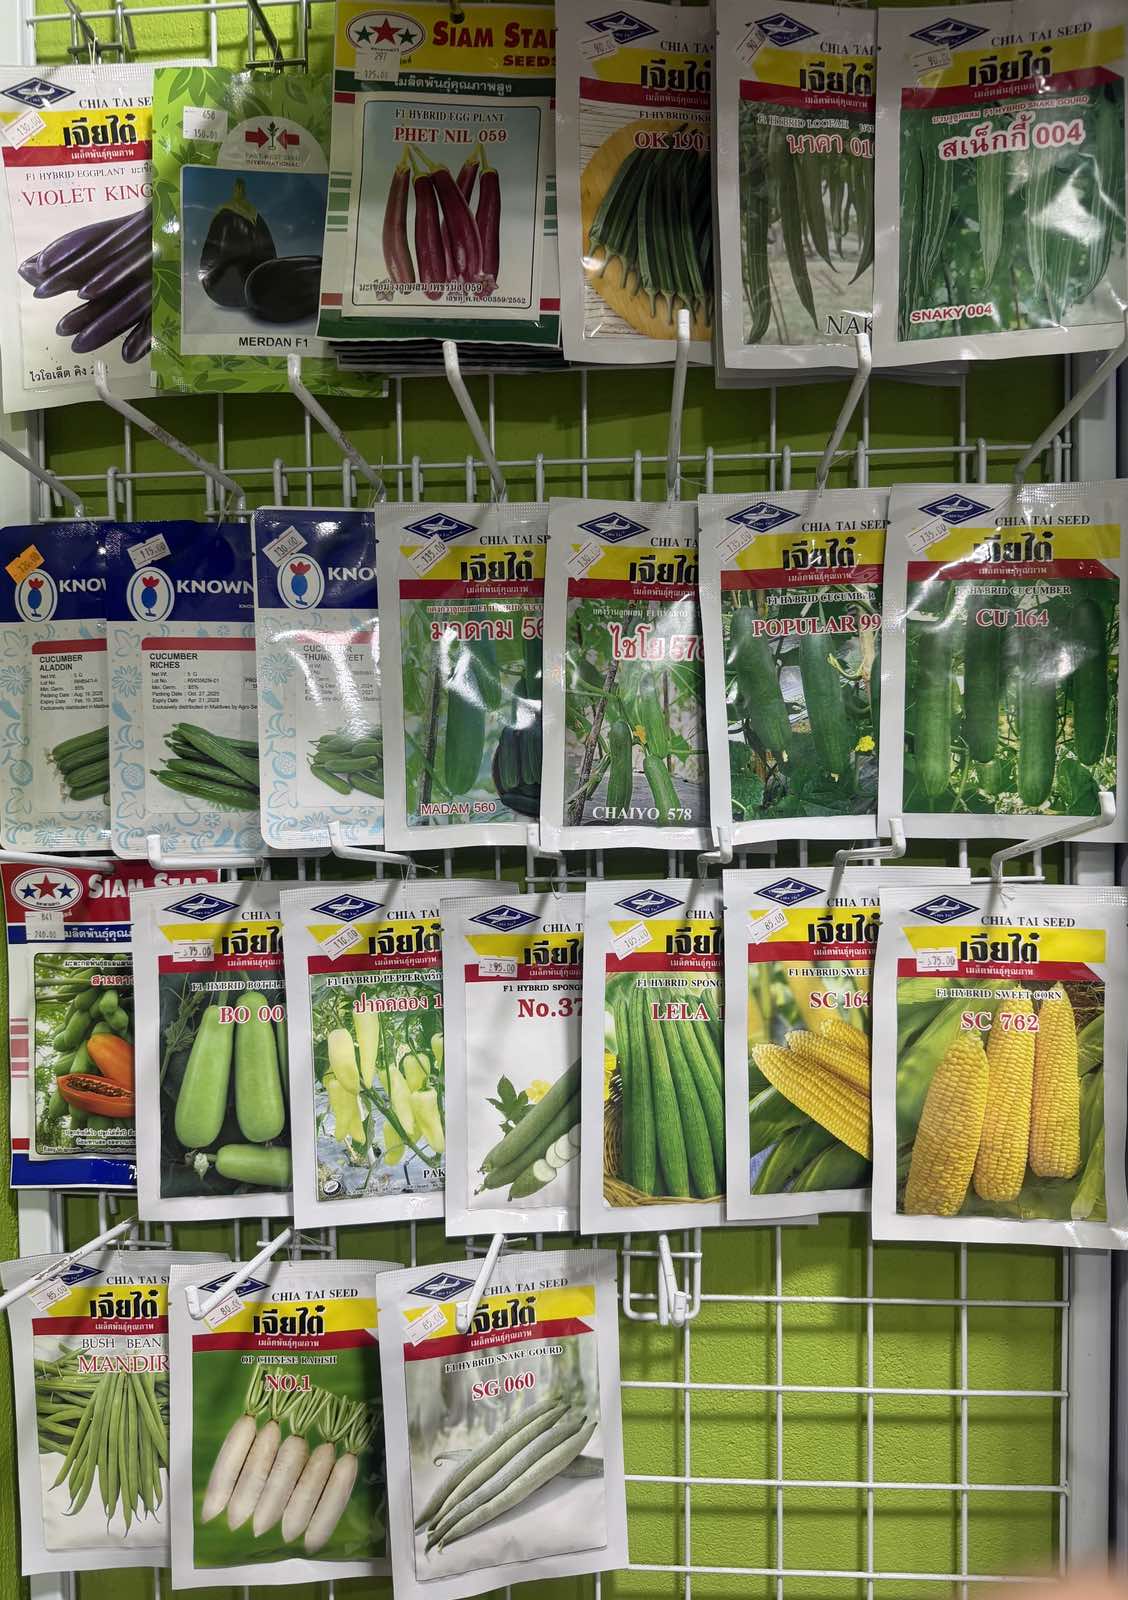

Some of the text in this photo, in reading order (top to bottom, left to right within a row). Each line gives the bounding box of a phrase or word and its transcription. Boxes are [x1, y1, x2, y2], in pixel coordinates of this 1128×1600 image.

[432, 20, 494, 48] SIAM
[991, 22, 1093, 47] CHIA TAI SEED
[660, 40, 689, 53] CHIA
[820, 41, 849, 55] CHIA
[79, 97, 133, 109] CHIA TAI
[395, 108, 505, 122] F1 HYBRID EGG PLANT
[639, 111, 688, 120] F1 HYBRID
[394, 127, 508, 143] PHET NIL 059
[634, 130, 669, 150] OK
[1036, 122, 1082, 145] 004
[26, 168, 126, 181] F1 HYBRID EGGPLANT
[22, 187, 96, 206] VIOLET
[911, 303, 993, 323] SNAKY 004
[239, 337, 308, 348] MERDAN F1
[801, 520, 856, 532] CHIA TAI
[995, 515, 1091, 527] CHIA TAI SEED
[479, 535, 508, 545] CHIA
[512, 535, 534, 544] TAI
[650, 537, 680, 547] CHIA
[328, 567, 378, 581] KNO
[969, 586, 1009, 595] HYBRID
[1010, 586, 1072, 595] CUCUMBER
[780, 590, 877, 605] HYBRID CUCUMBER
[976, 609, 1049, 627] CU 164
[752, 614, 856, 637] POPULAR
[40, 655, 83, 663] CUCUMBER
[40, 663, 73, 671] ALADDIN
[420, 802, 497, 816] MADAM 560
[592, 806, 692, 821] CHAIYO 578
[826, 897, 880, 907] CHIA TAI
[241, 911, 270, 921] CHIA
[386, 909, 440, 920] CHIA TAI
[685, 910, 714, 919] CHIA
[542, 923, 571, 933] CHIA
[981, 916, 1076, 928] CHIA TAI SEED
[801, 968, 839, 976] HYBRID
[191, 981, 246, 991] F1 HYBRID
[327, 973, 421, 986] F1 HYBRID PEPPER
[636, 979, 688, 987] F1 HYBRID
[516, 984, 549, 992] HYBRID
[936, 988, 1063, 1000] F1 HYBRID SWEET CORN
[809, 991, 872, 1009] SC 164
[218, 1004, 285, 1024] BO 00
[652, 1002, 710, 1021] LELA
[961, 1010, 1040, 1032] SC 762
[423, 1168, 446, 1179] PAK
[107, 1276, 135, 1285] CHIA
[138, 1275, 158, 1284] TAI
[483, 1278, 568, 1297] CHIA TAI SEED
[271, 1289, 359, 1302] CHIA TAI SEED
[82, 1337, 162, 1349] BUSH BEAN
[257, 1356, 338, 1364] CHINESE RADISH
[445, 1345, 563, 1374] F1 HYBRID SNAKE GOURD
[264, 1374, 313, 1393] NO.1
[472, 1372, 536, 1400] SG 060
